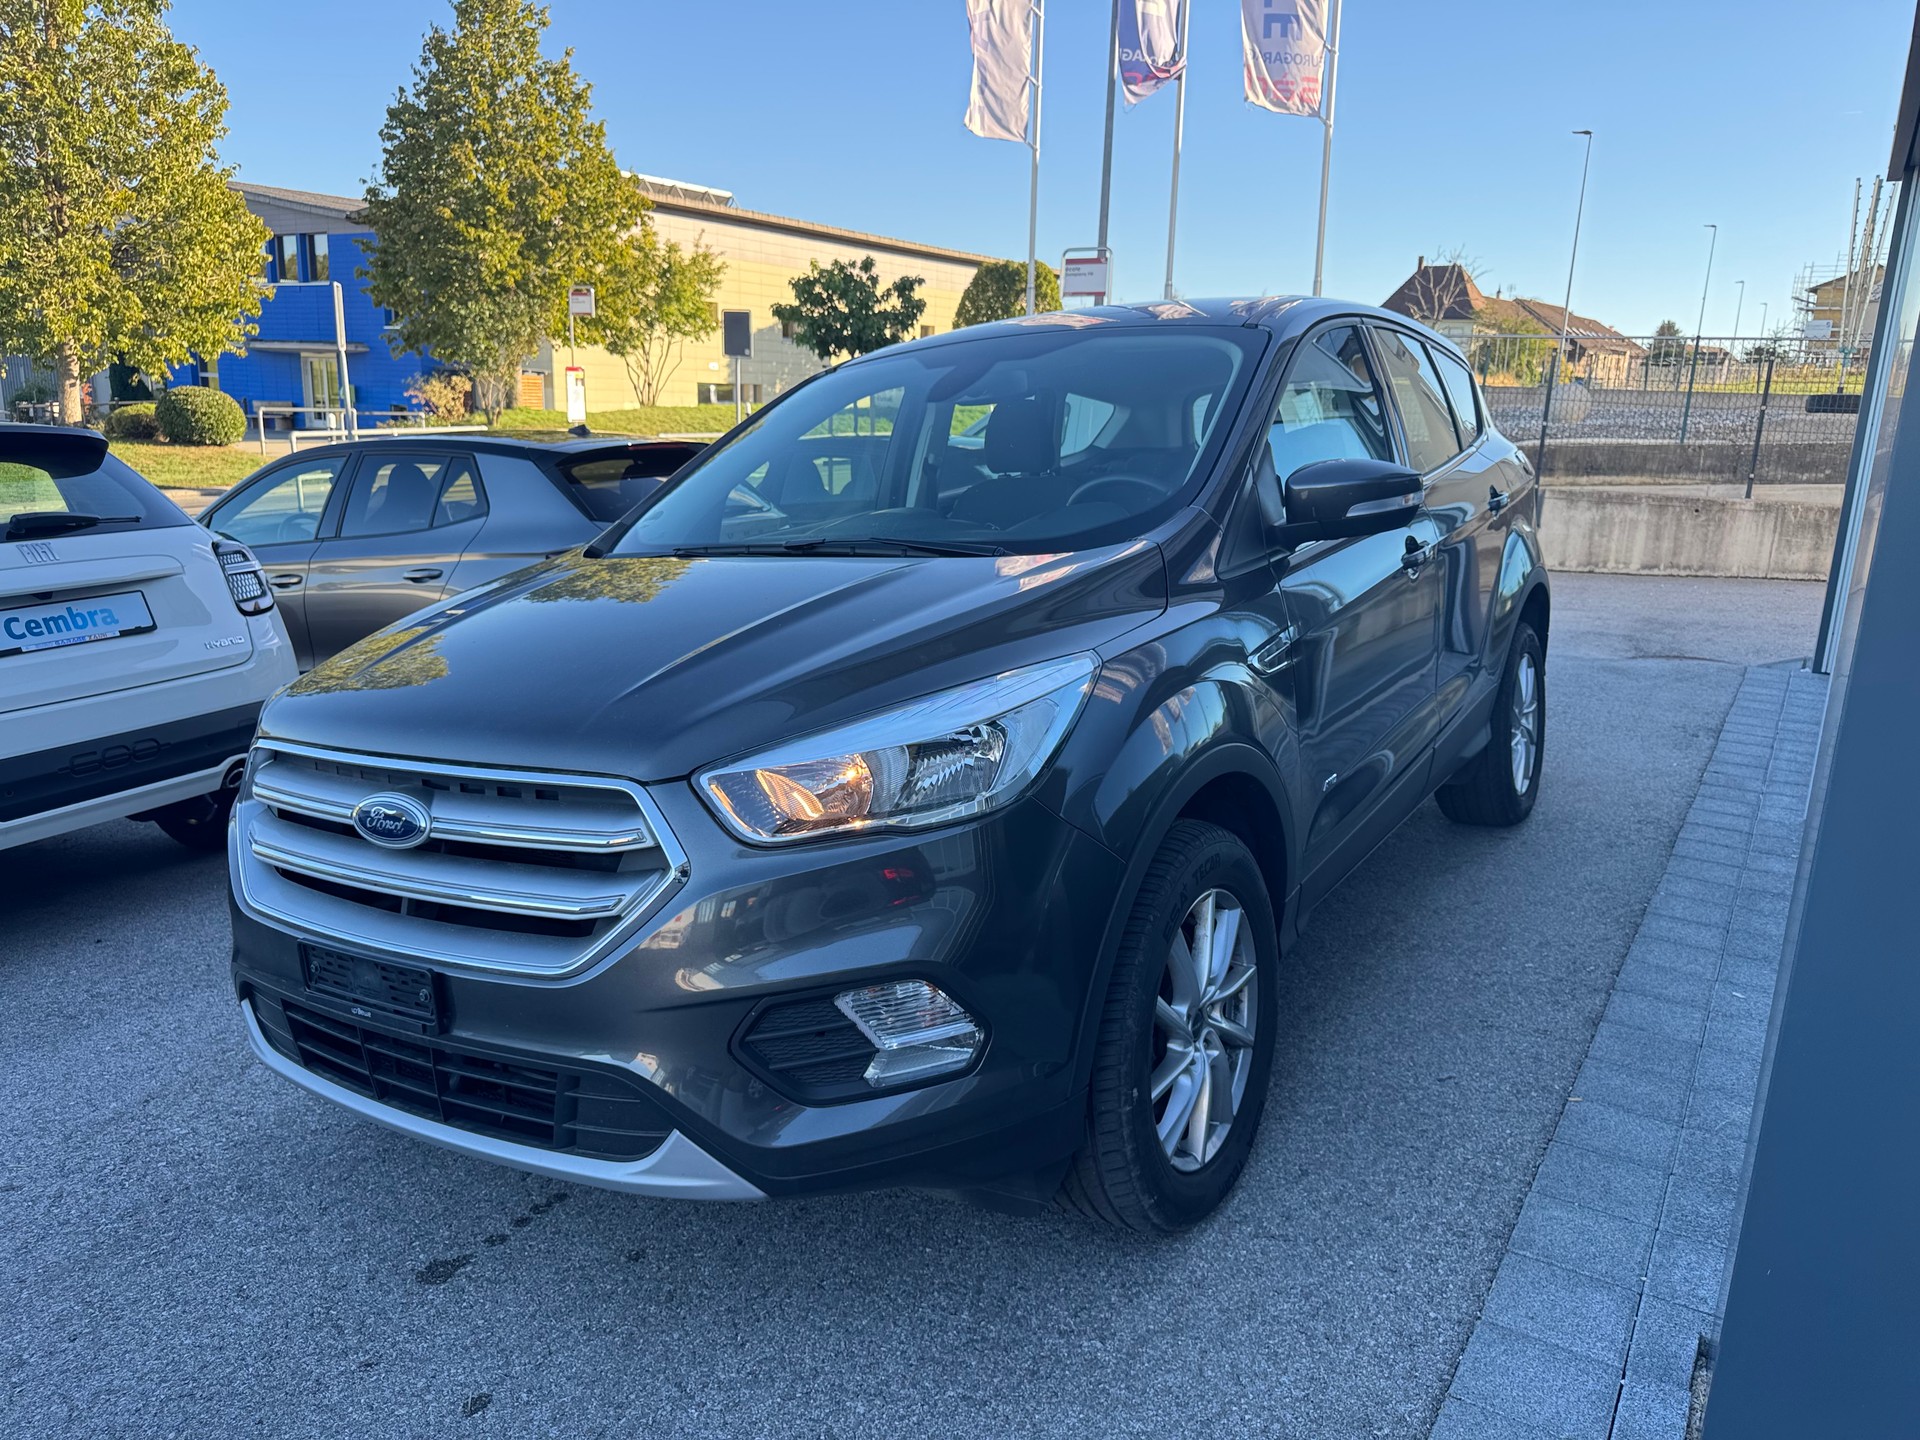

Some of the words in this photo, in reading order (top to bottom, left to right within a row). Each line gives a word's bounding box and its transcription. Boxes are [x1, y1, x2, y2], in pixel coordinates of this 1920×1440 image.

[3, 606, 119, 640] Cembra
[204, 635, 245, 650] HYBRID
[366, 806, 406, 834] Ford
